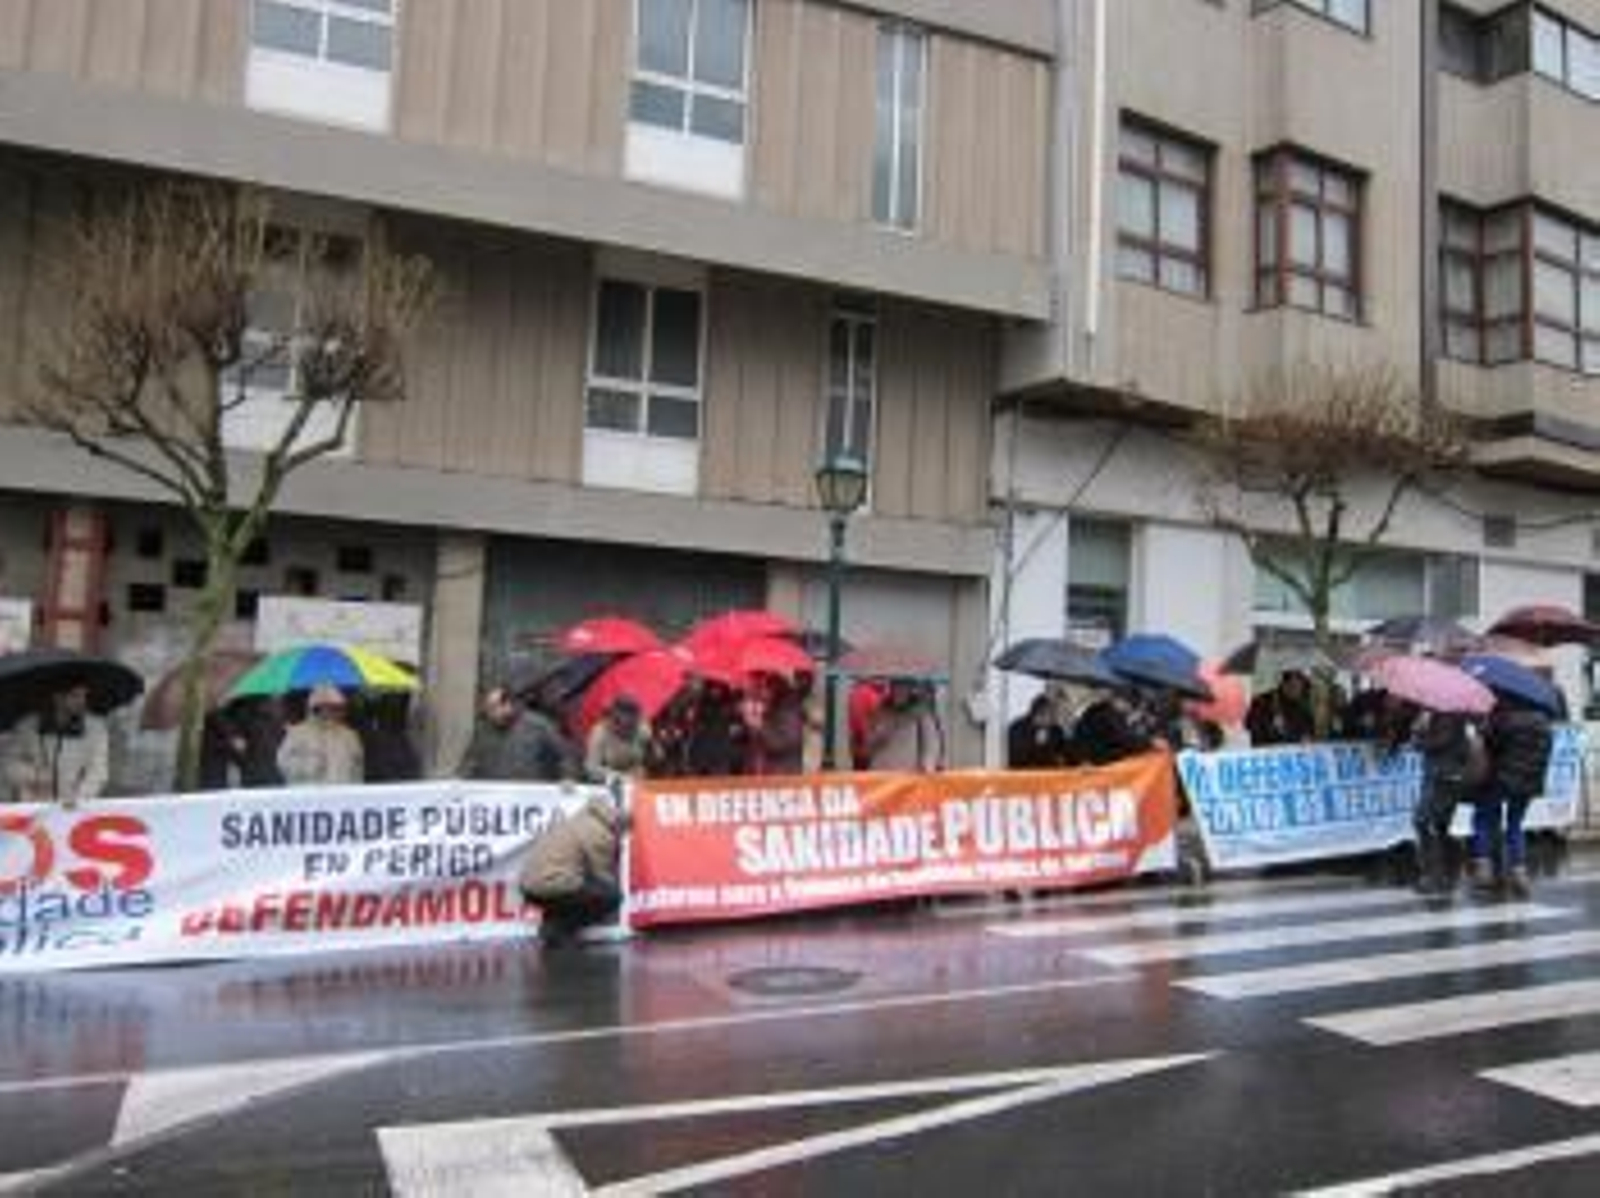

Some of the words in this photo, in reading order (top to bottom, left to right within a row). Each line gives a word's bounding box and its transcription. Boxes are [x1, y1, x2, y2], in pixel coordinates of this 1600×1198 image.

[221, 807, 408, 849] SANIDADE
[735, 812, 938, 876] SANIDADE
[938, 788, 1138, 858] PÚBLICA
[304, 853, 349, 880] EN
[364, 842, 494, 877] PERIGO
